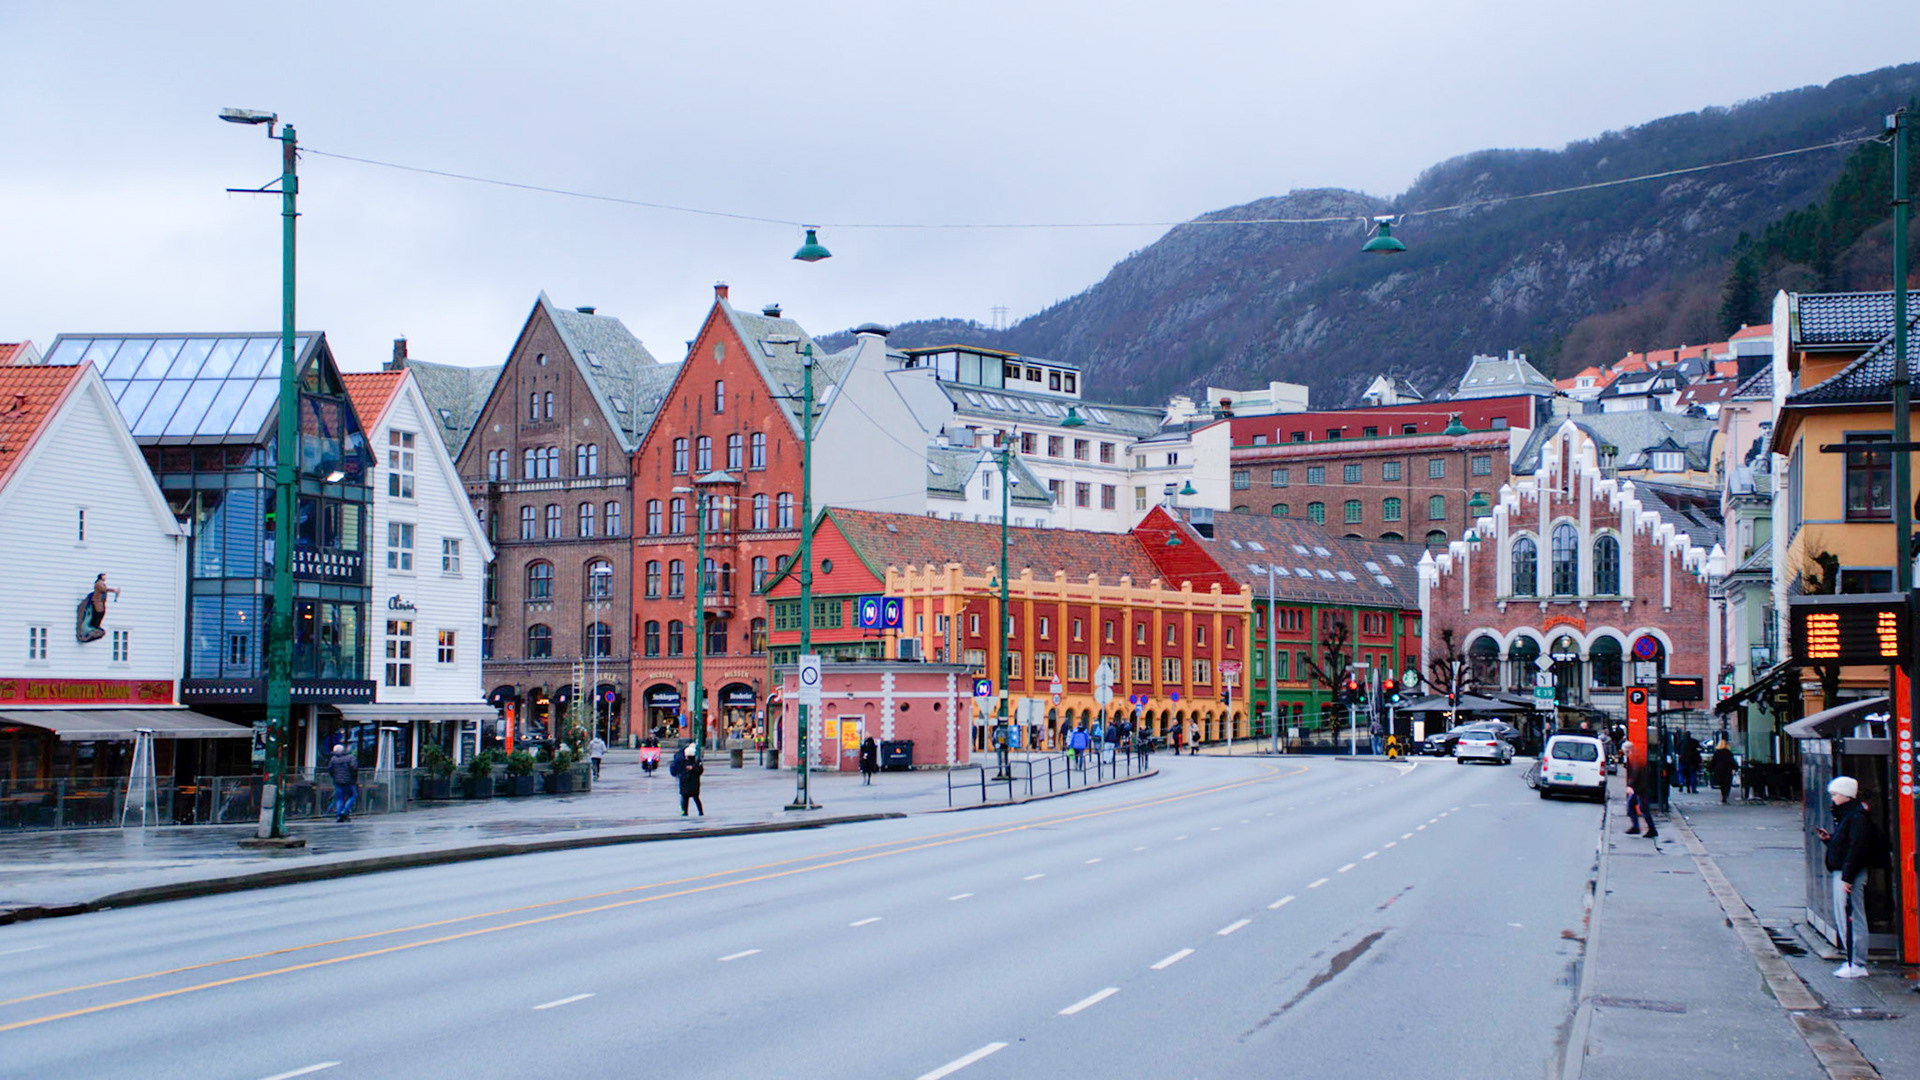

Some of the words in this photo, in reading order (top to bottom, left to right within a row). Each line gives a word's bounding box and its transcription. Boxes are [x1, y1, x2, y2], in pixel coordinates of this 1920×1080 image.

[293, 551, 361, 567] ESTAURANT
[866, 606, 875, 618] N
[888, 607, 896, 619] N
[724, 670, 750, 678] NILSSEN
[184, 687, 254, 695] RESTAURANT
[290, 687, 371, 695] HARIASBRYGGEN
[1633, 692, 1641, 702] P
